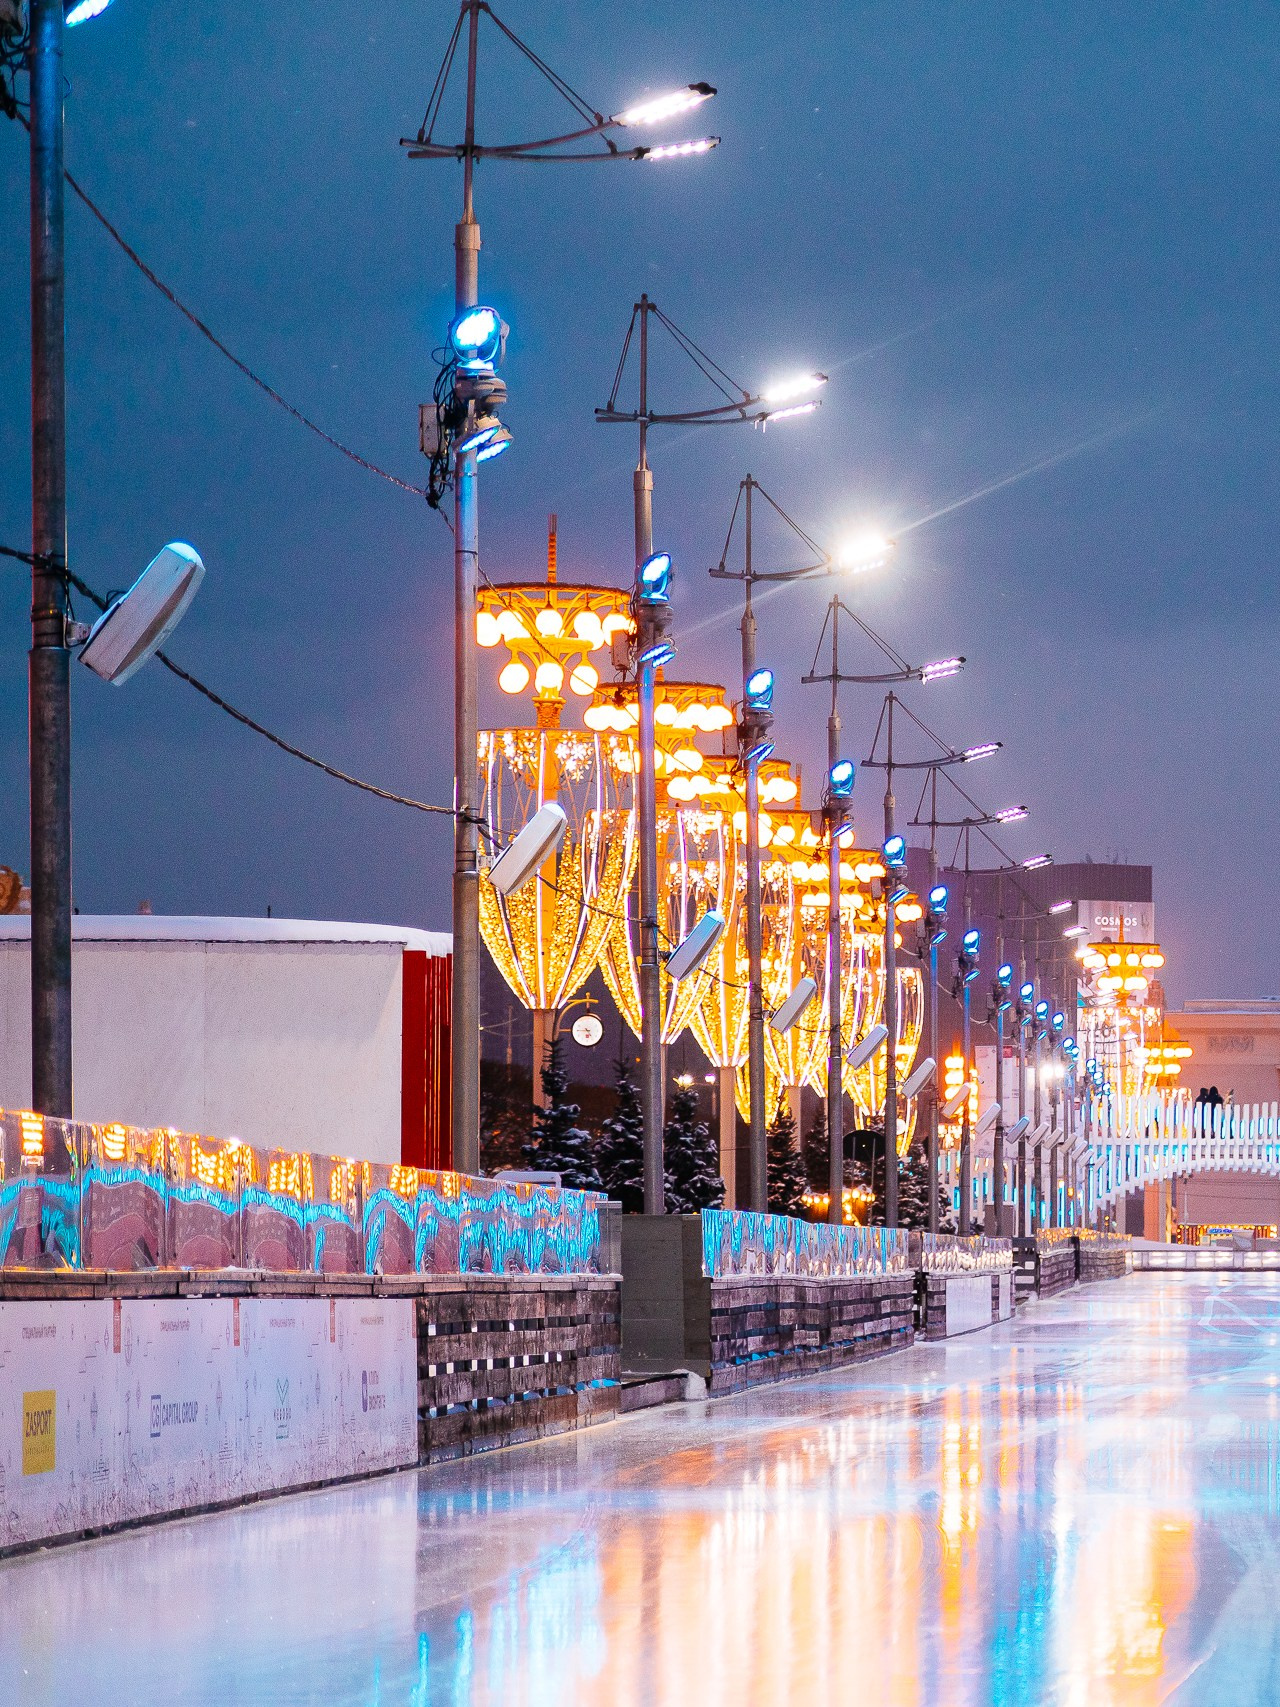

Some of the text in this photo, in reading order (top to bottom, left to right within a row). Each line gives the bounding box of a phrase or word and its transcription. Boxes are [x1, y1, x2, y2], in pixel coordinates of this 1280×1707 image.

[25, 1409, 52, 1438] ZASPORT
[162, 1402, 181, 1426] CAPITAL
[182, 1401, 199, 1424] GROUP
